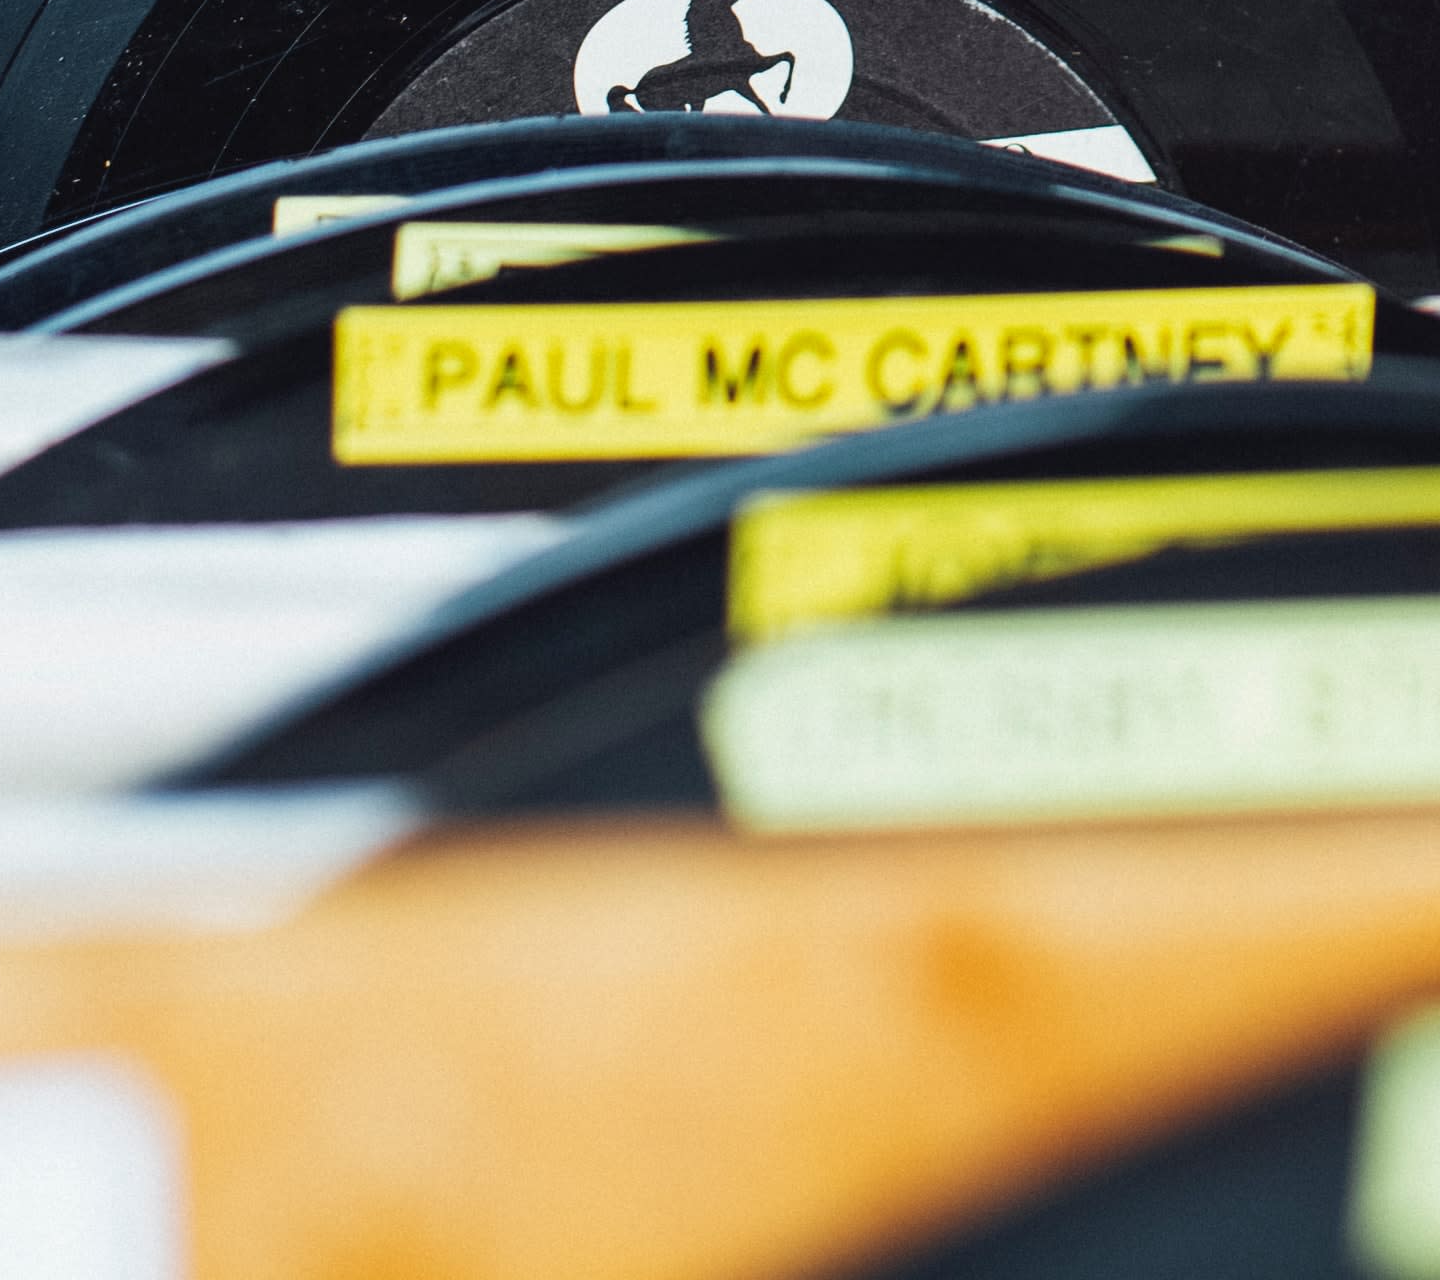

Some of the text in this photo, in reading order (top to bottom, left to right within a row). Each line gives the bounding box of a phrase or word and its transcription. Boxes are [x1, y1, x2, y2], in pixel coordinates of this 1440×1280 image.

[421, 312, 1294, 418] PAUL MC CARTNEY
